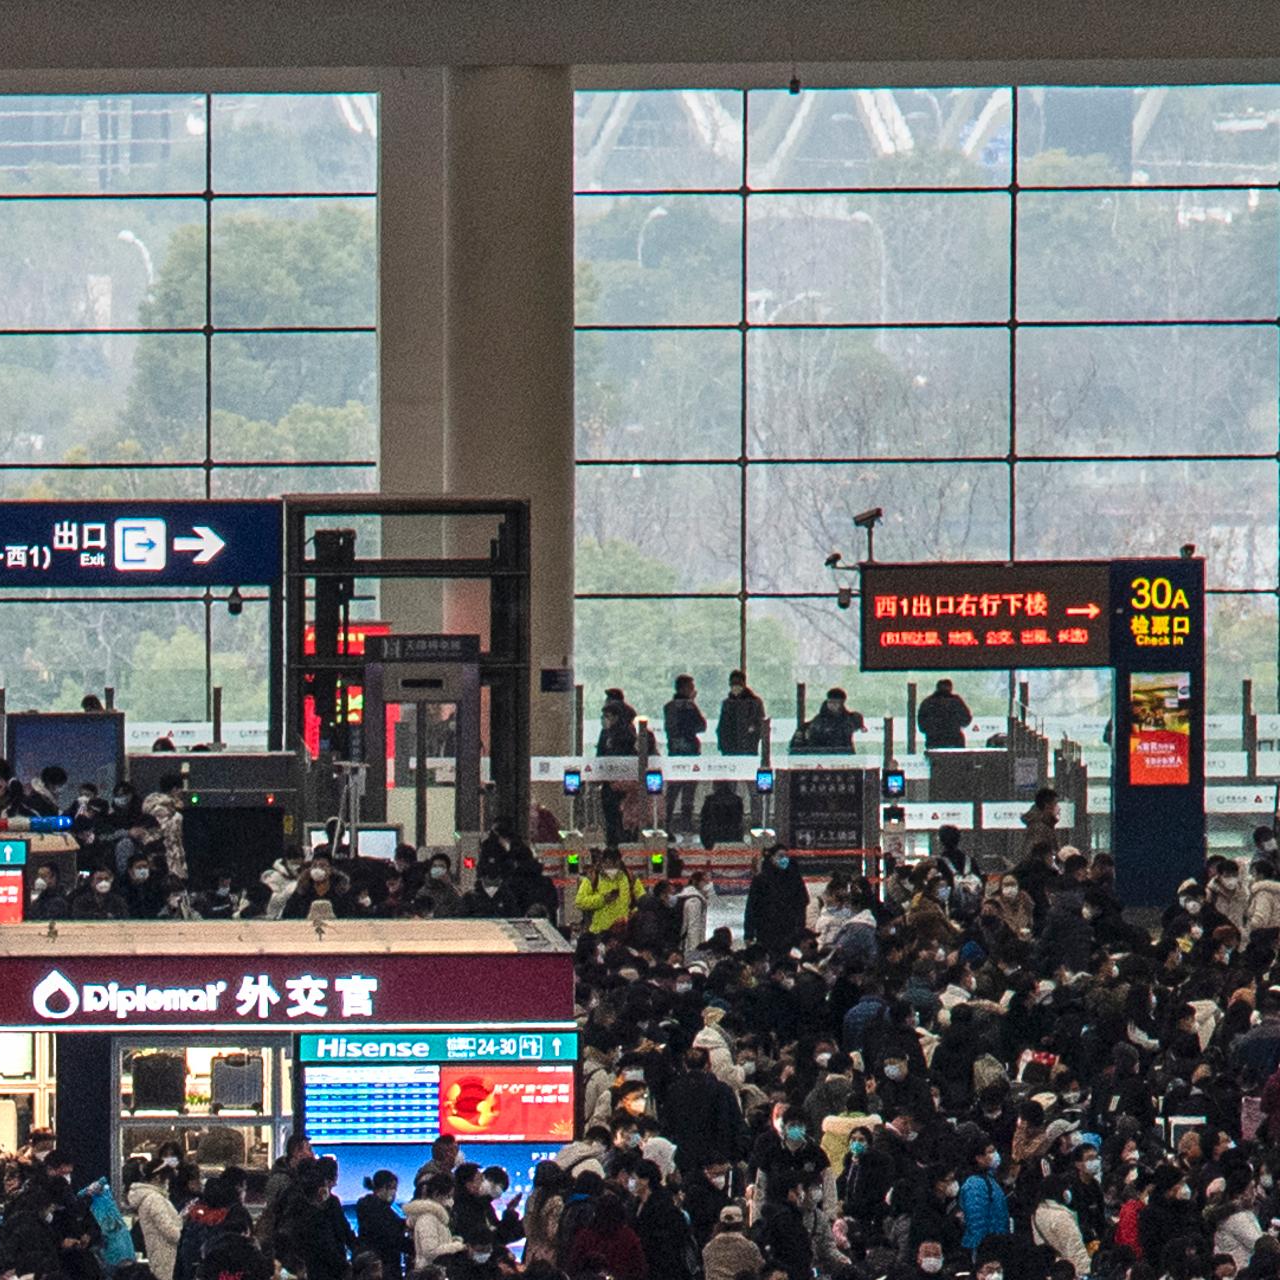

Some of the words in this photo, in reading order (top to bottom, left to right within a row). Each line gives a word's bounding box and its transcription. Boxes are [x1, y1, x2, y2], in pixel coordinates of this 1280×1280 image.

[54, 522, 107, 550] 出口
[80, 552, 106, 567] Exit
[874, 592, 1048, 618] 西1出口右行下楼
[1131, 577, 1189, 610] 30A
[1130, 616, 1189, 635] 检票口
[236, 975, 377, 1018] 外交官
[317, 1038, 430, 1058] Hisense
[478, 1038, 517, 1055] 24-30
